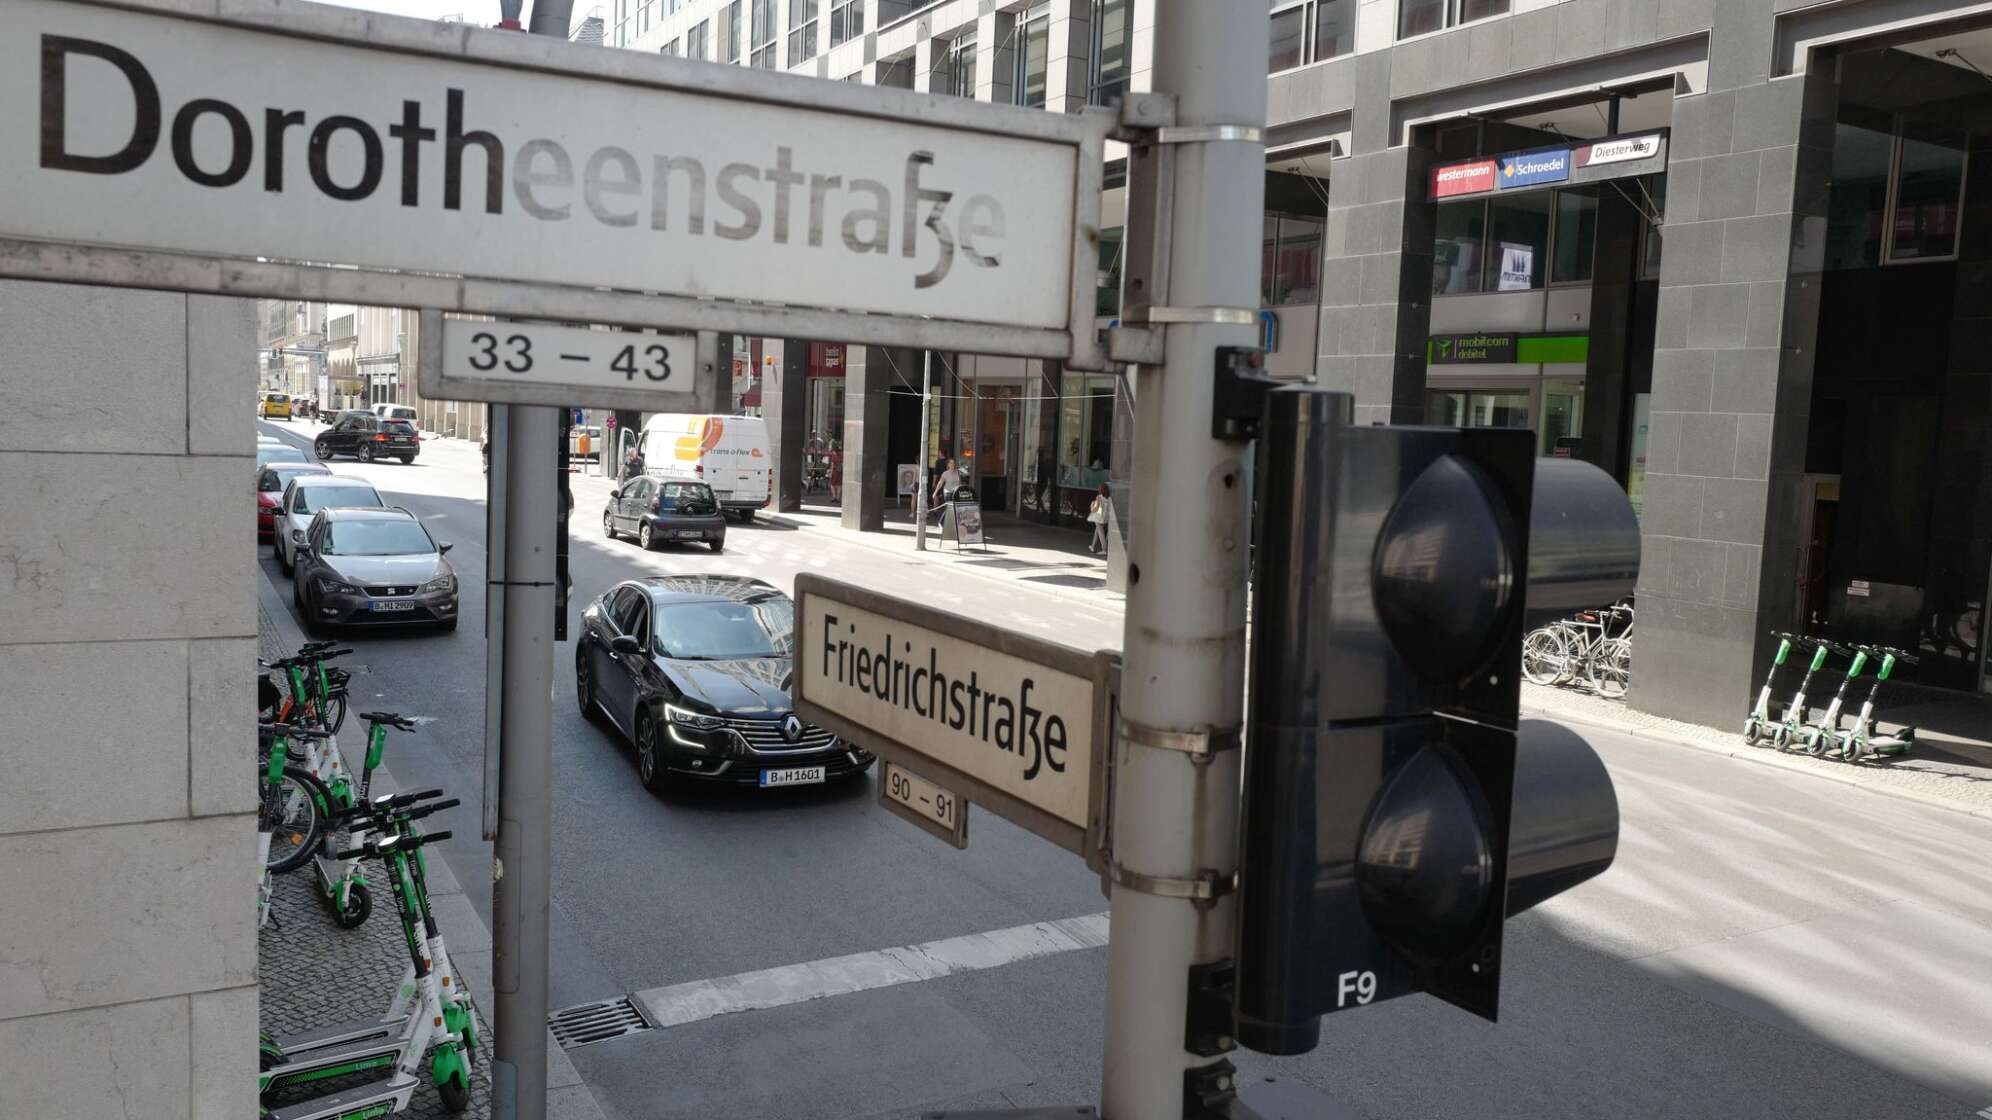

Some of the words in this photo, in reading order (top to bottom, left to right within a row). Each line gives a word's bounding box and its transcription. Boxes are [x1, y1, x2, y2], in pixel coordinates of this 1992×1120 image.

[40, 33, 1006, 289] Dorotheenstraße
[1517, 158, 1564, 176] Schroedel
[1595, 140, 1650, 158] Diesterweg
[469, 332, 533, 373] 33
[609, 344, 671, 382] 43
[823, 613, 1067, 781] Friedrichstraße
[891, 771, 911, 803] 90
[936, 794, 954, 822] 91
[1337, 969, 1377, 1007] F9
